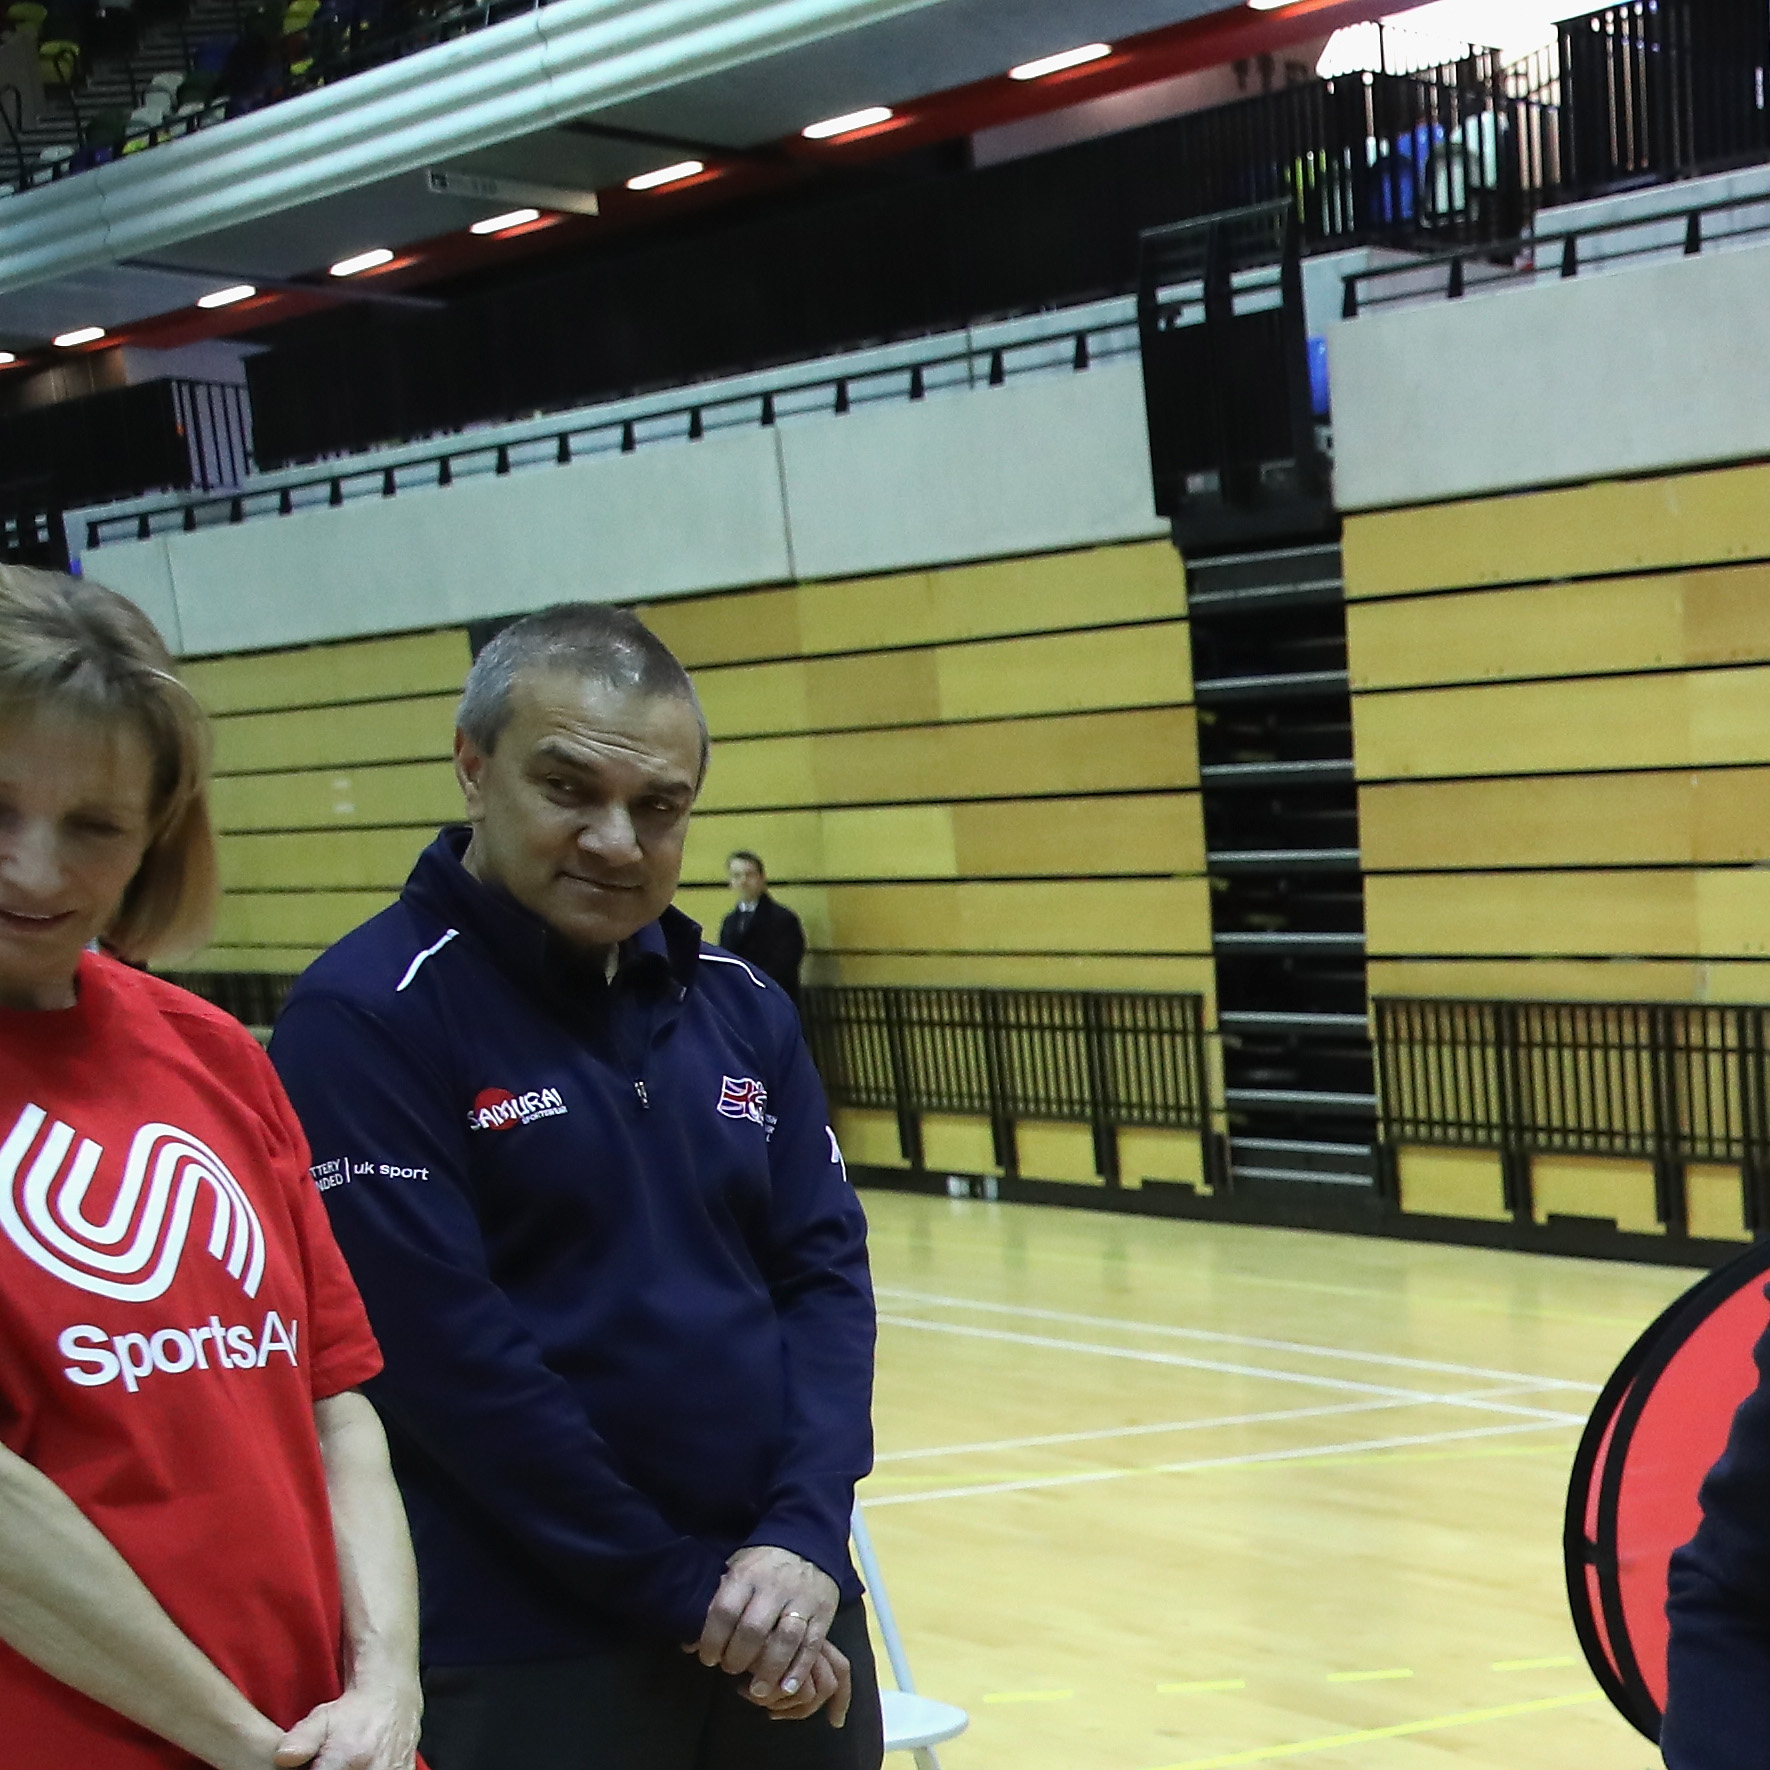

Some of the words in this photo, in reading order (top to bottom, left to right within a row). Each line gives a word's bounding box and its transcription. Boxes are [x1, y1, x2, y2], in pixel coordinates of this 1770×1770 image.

[467, 1087, 563, 1131] SAMURAI
[309, 1158, 341, 1178] TTERY
[353, 1160, 375, 1175] uk
[379, 1163, 429, 1181] sport
[315, 1173, 344, 1192] NDED
[57, 1310, 298, 1393] SportsA
